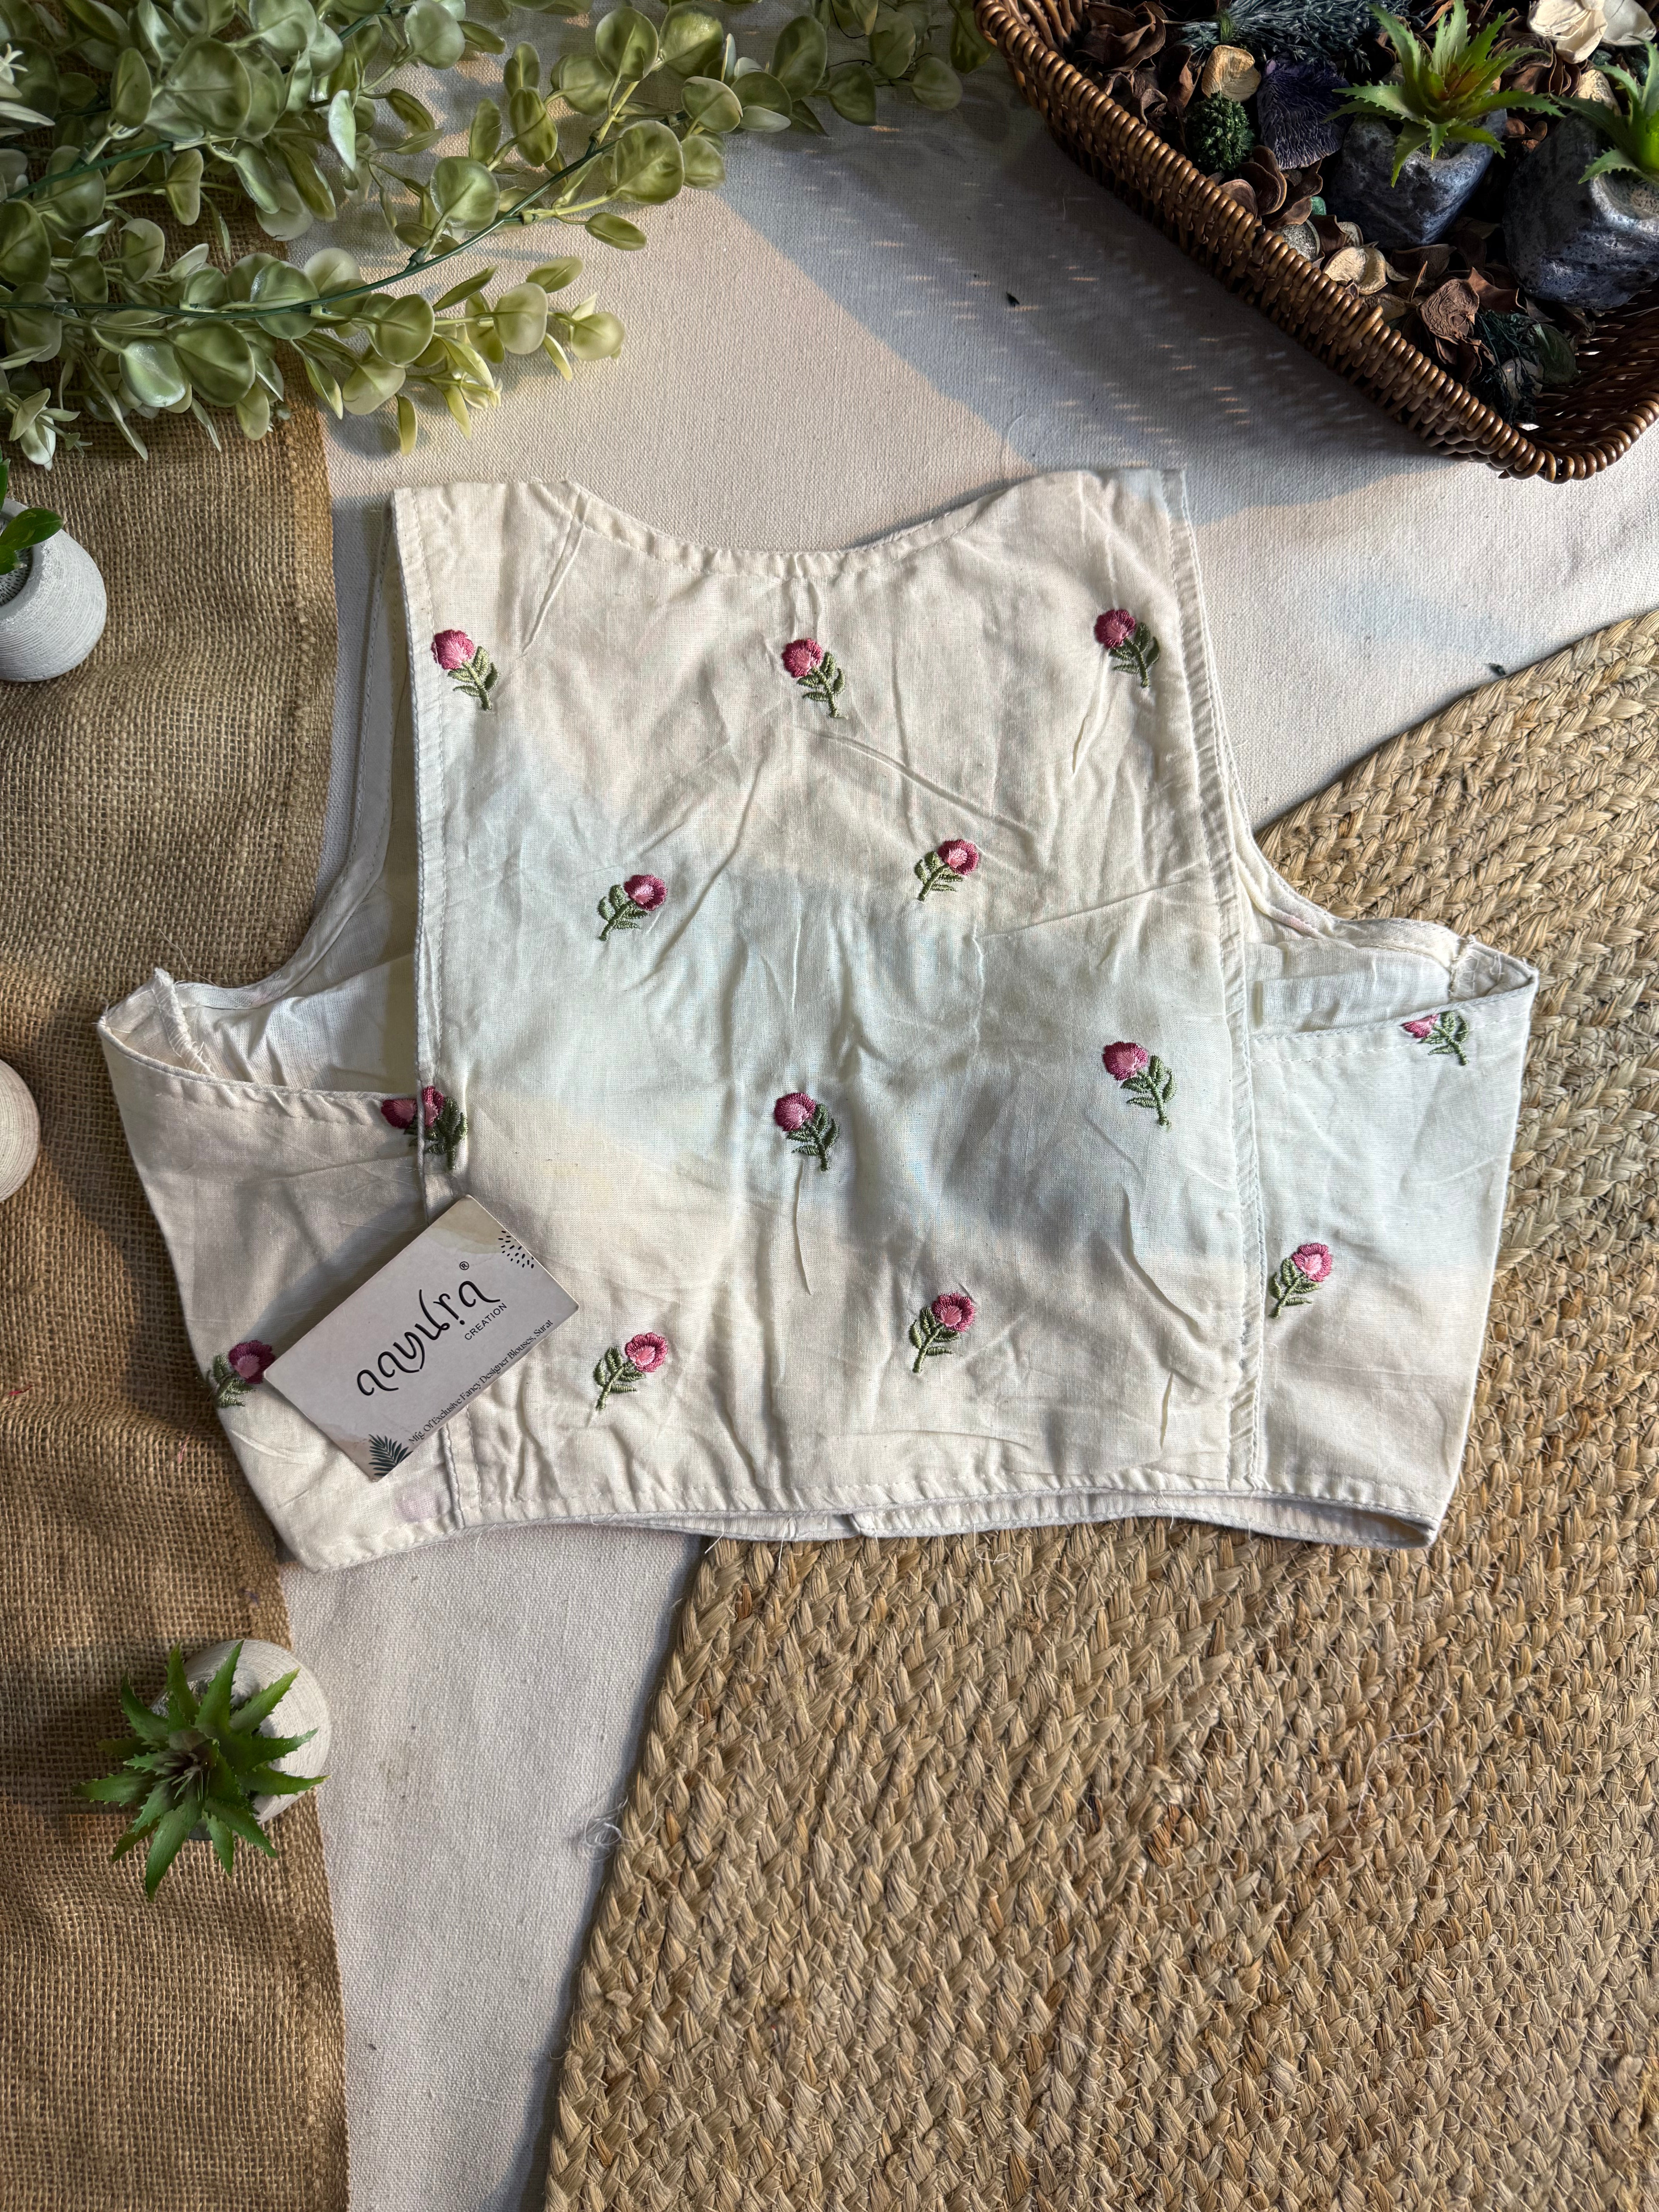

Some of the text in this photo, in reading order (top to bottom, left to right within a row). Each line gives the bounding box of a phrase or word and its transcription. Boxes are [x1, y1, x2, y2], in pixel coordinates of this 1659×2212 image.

[464, 1302, 507, 1340] CREATION
[408, 1320, 553, 1444] Mfg. Of Exclusive Fancy Designer Blouses, Surat
